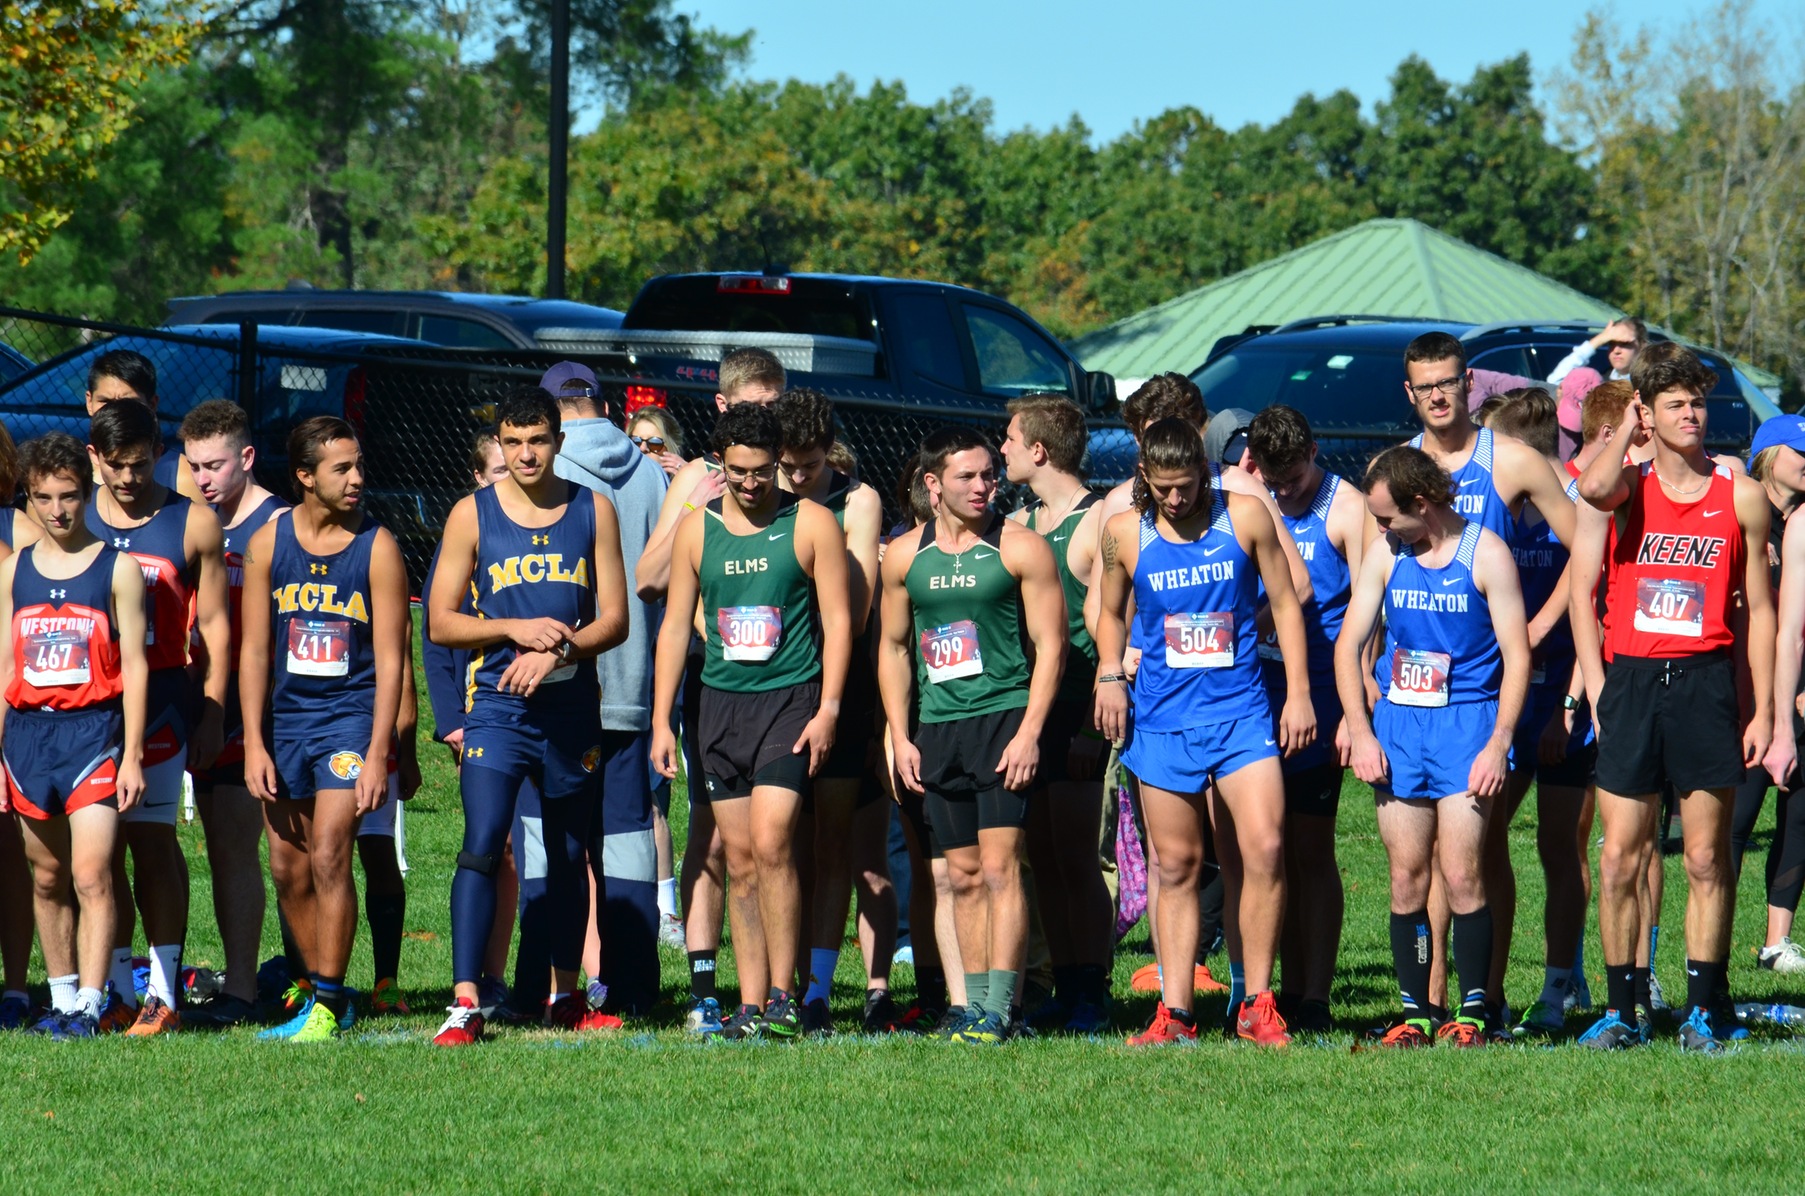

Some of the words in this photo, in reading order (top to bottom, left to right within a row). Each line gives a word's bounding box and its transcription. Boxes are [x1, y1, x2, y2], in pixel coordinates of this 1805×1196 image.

[1636, 532, 1726, 568] KEENE
[487, 553, 589, 595] MCLA
[725, 557, 768, 575] ELMS
[1147, 560, 1234, 592] WHEATON
[929, 574, 976, 589] ELMS
[272, 582, 369, 624] MCLA
[1391, 588, 1469, 612] WHEATON
[1649, 591, 1689, 619] 407
[730, 619, 766, 645] 300
[1180, 626, 1219, 652] 504
[36, 643, 73, 669] 467
[297, 634, 332, 660] 411
[931, 636, 963, 667] 299
[1400, 662, 1433, 690] 503
